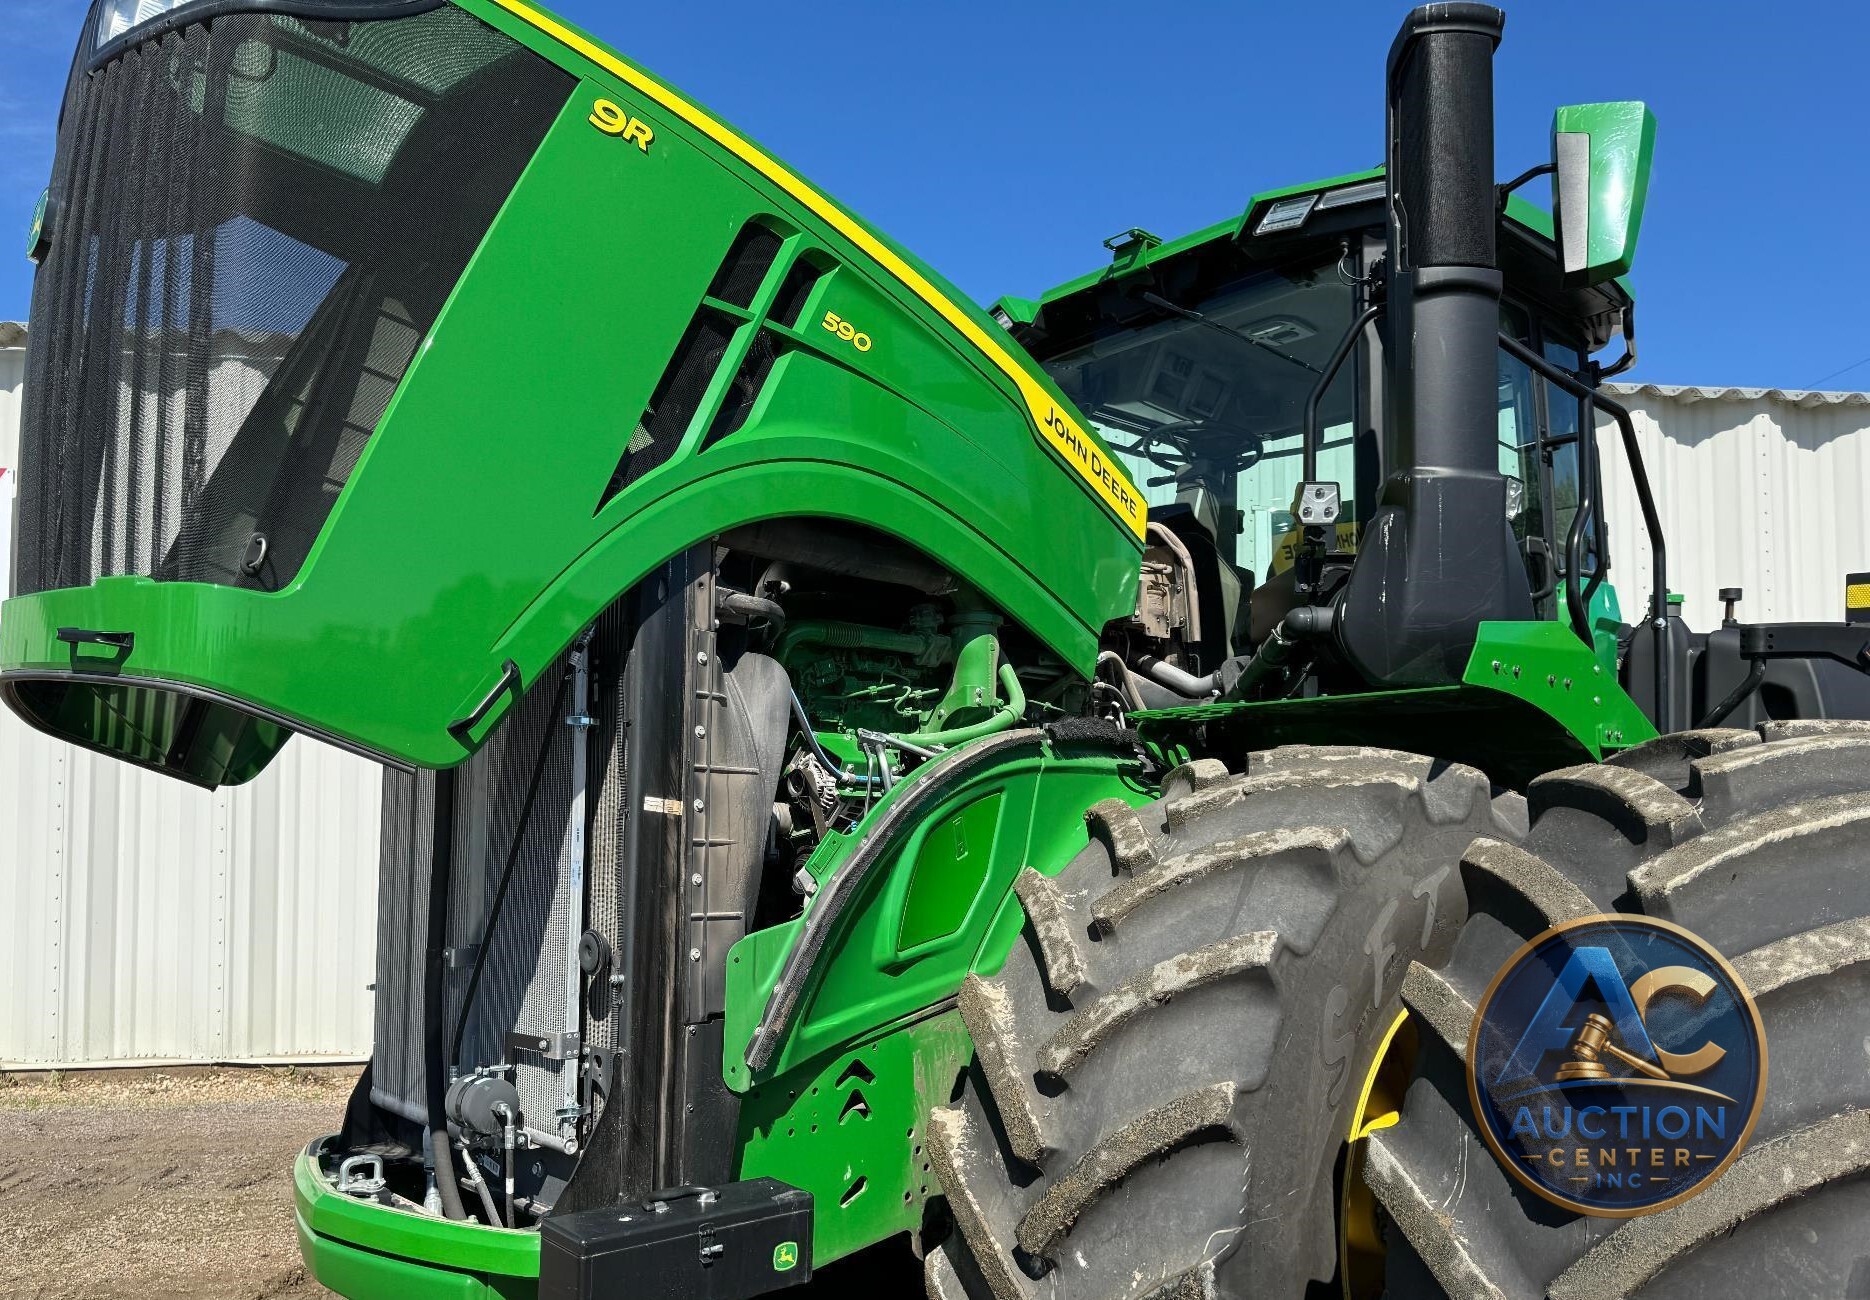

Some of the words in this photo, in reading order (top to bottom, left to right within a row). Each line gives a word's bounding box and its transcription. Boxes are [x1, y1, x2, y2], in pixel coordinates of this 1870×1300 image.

[588, 98, 655, 155] 9R
[821, 310, 872, 352] 590
[1044, 406, 1088, 465] JOHN
[1091, 450, 1137, 519] DEERE
